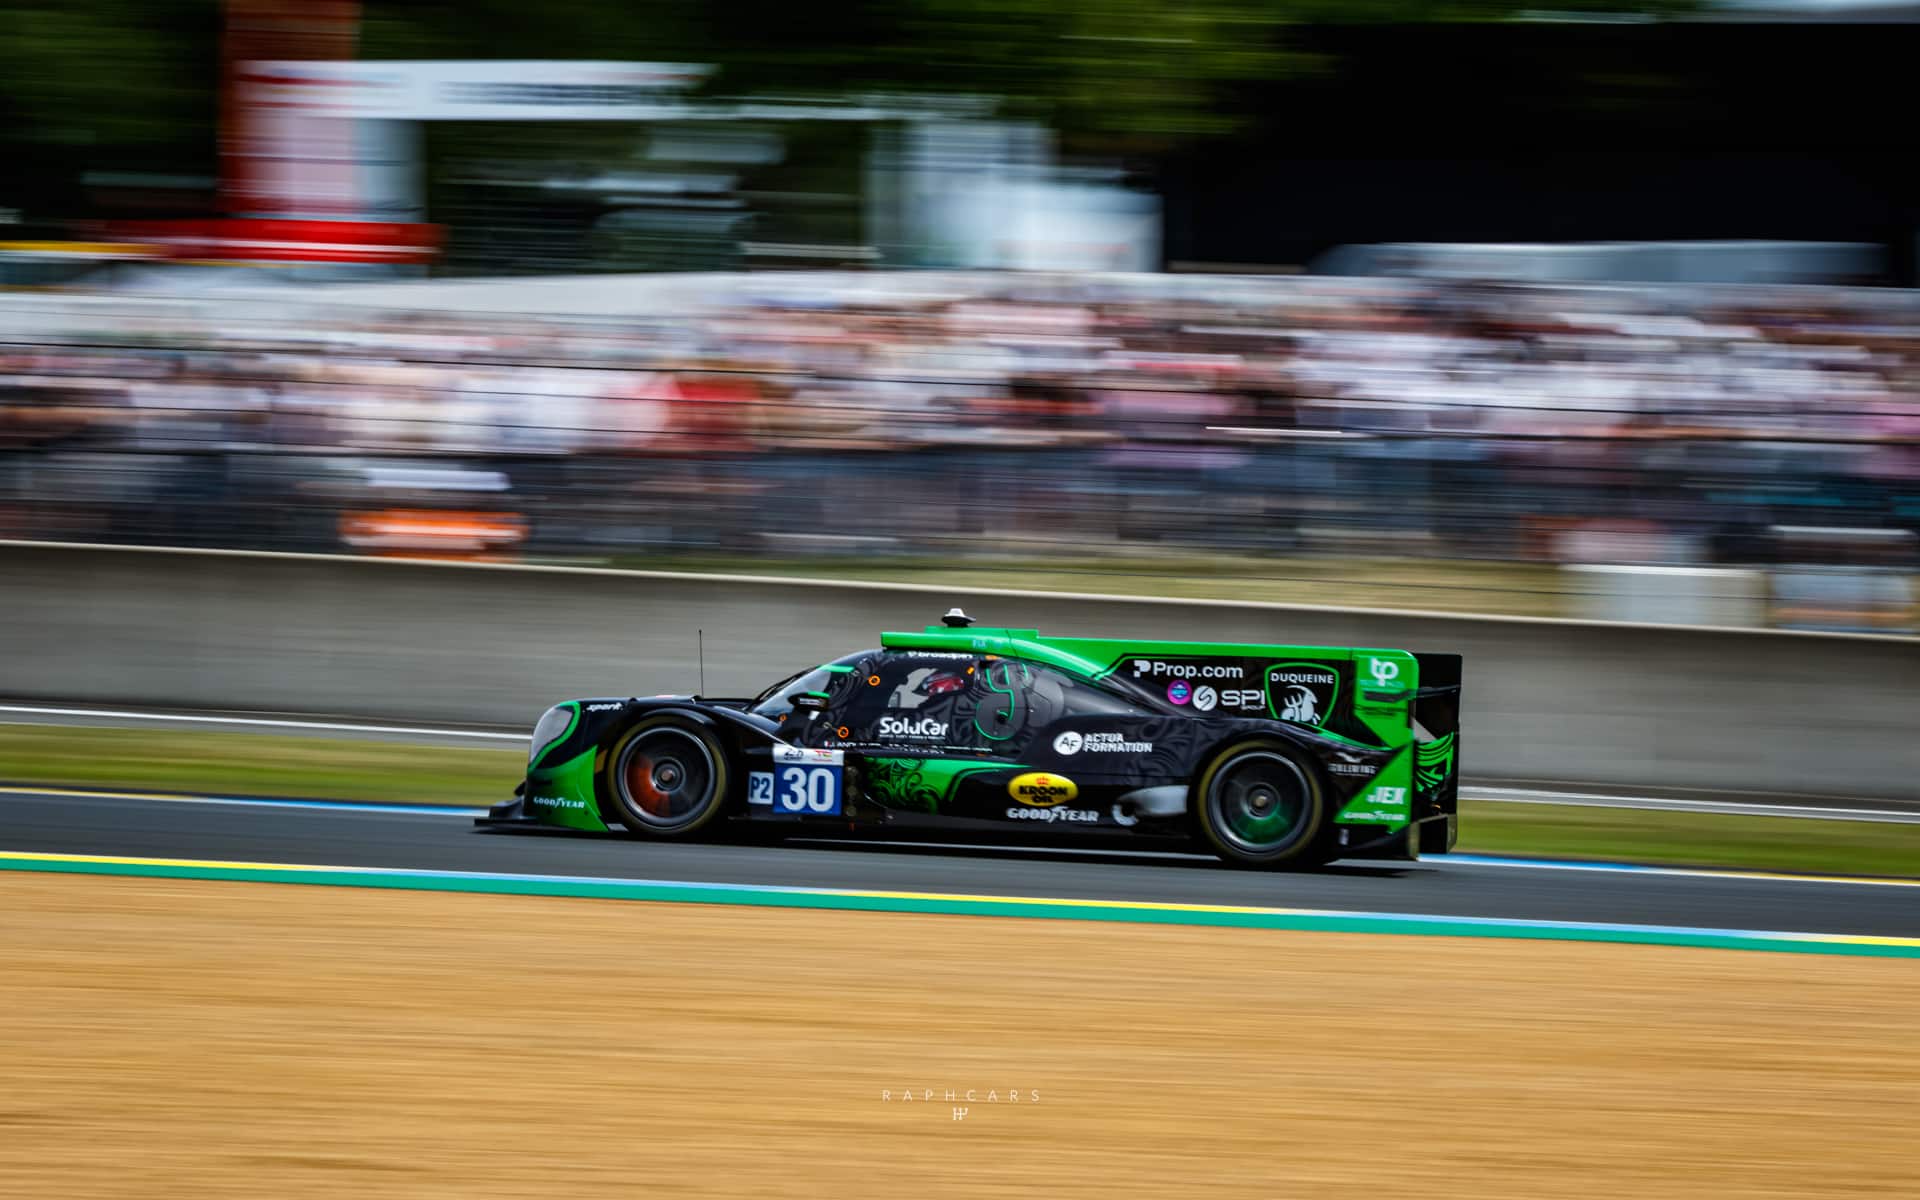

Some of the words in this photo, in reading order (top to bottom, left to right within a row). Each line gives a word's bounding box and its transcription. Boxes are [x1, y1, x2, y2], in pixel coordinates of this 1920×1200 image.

[1153, 661, 1244, 679] Prop.com
[1270, 672, 1335, 684] DUQUEINE
[1221, 690, 1266, 706] SPI
[879, 717, 949, 736] SoluCar
[1083, 733, 1124, 743] ACTUA
[1082, 742, 1153, 753] FORMATION
[750, 776, 771, 800] P2
[781, 767, 835, 812] 30
[1019, 785, 1069, 795] KROON
[533, 796, 585, 809] GOODYEAR
[1032, 795, 1055, 803] OIL
[1006, 806, 1100, 823] GOODYEAR
